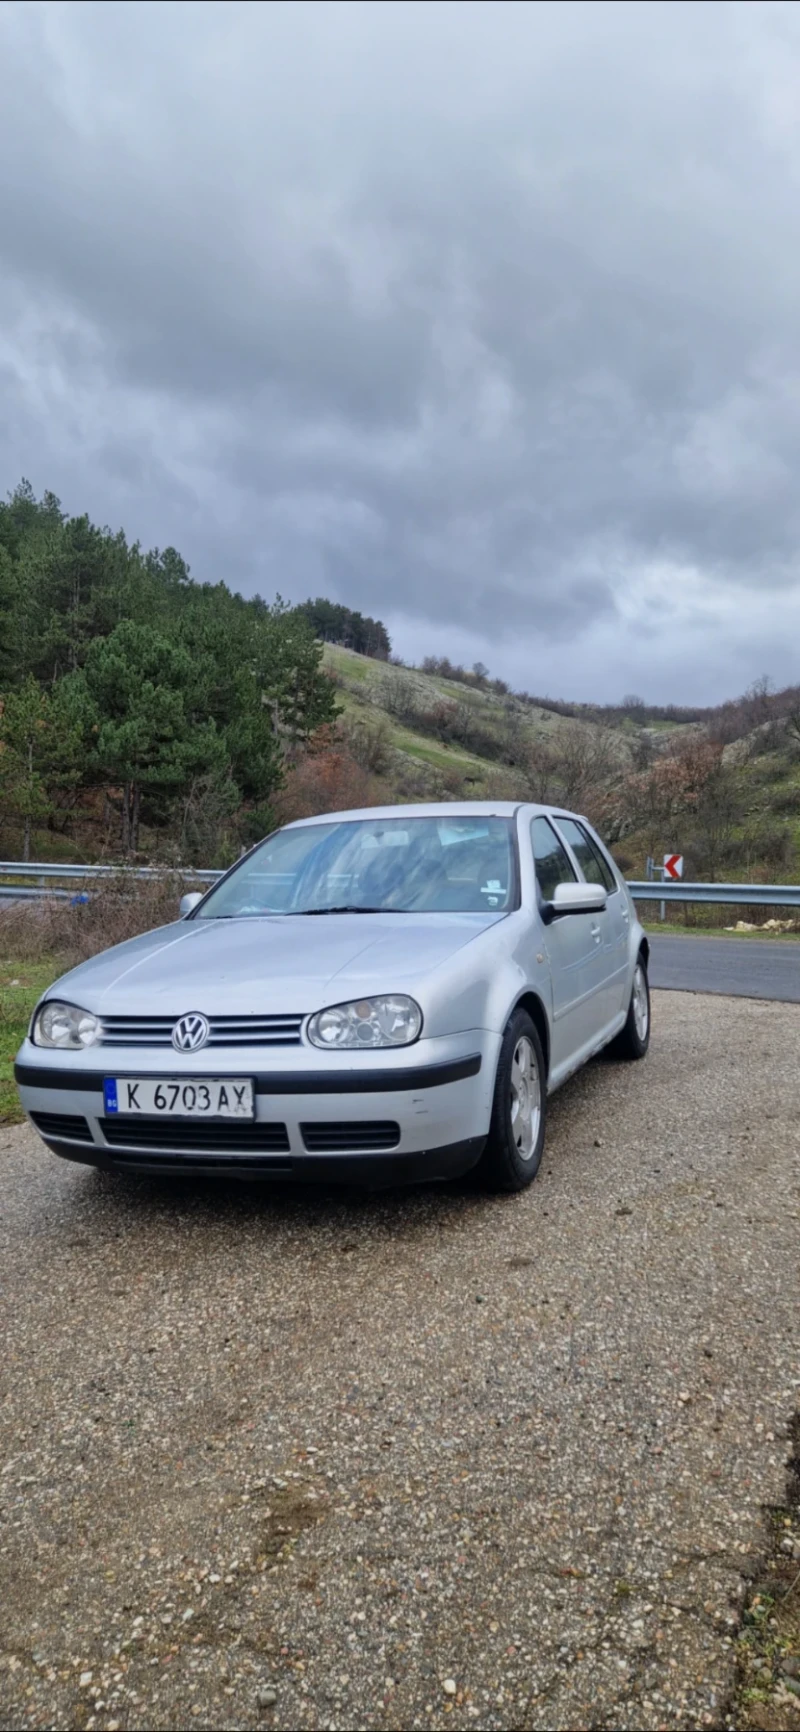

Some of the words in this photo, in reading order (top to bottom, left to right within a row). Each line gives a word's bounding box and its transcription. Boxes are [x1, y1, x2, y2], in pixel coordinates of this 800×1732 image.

[174, 1015, 207, 1050] VW
[126, 1083, 141, 1109] K
[153, 1084, 211, 1111] 6703
